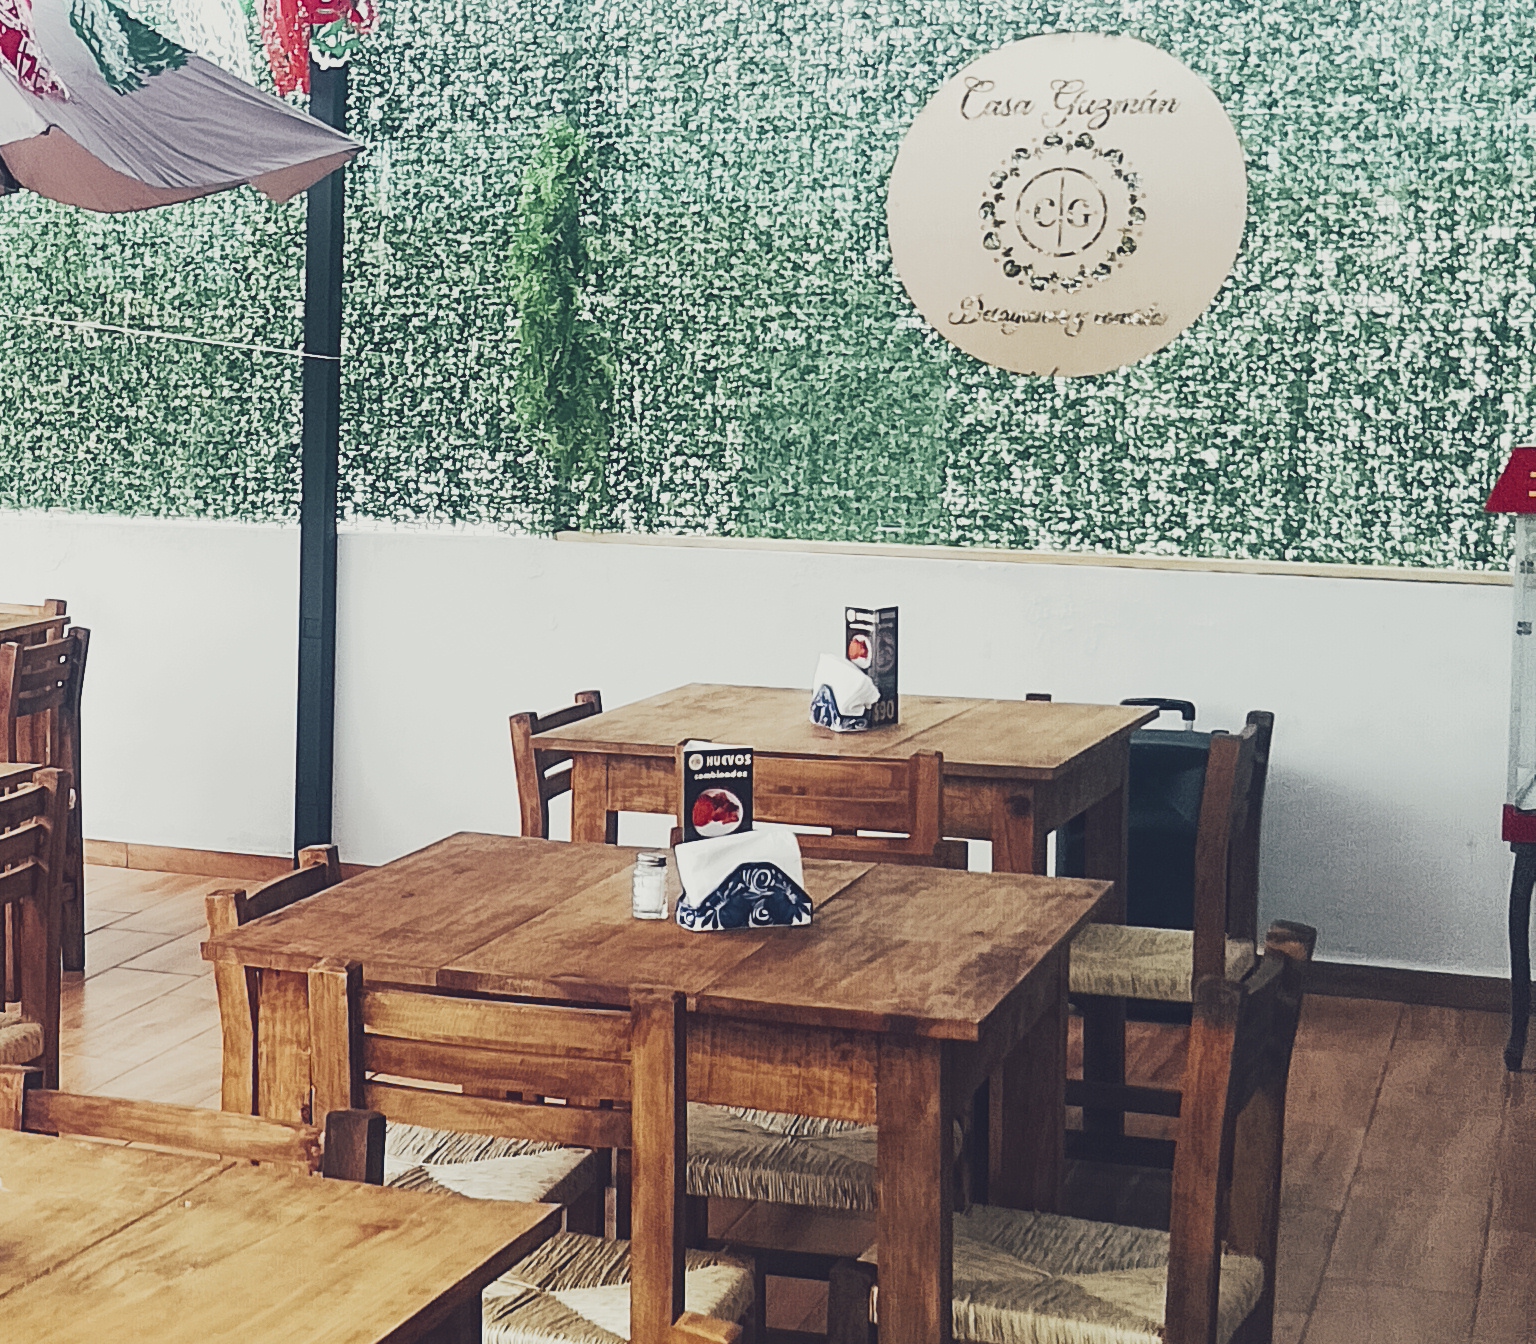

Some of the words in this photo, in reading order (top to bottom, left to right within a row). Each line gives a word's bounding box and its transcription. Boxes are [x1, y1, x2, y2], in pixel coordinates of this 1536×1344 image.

[960, 76, 1035, 121] Casa
[1041, 78, 1182, 130] Guzmán
[706, 753, 752, 767] HUEVOS
[694, 769, 748, 781] combinados
